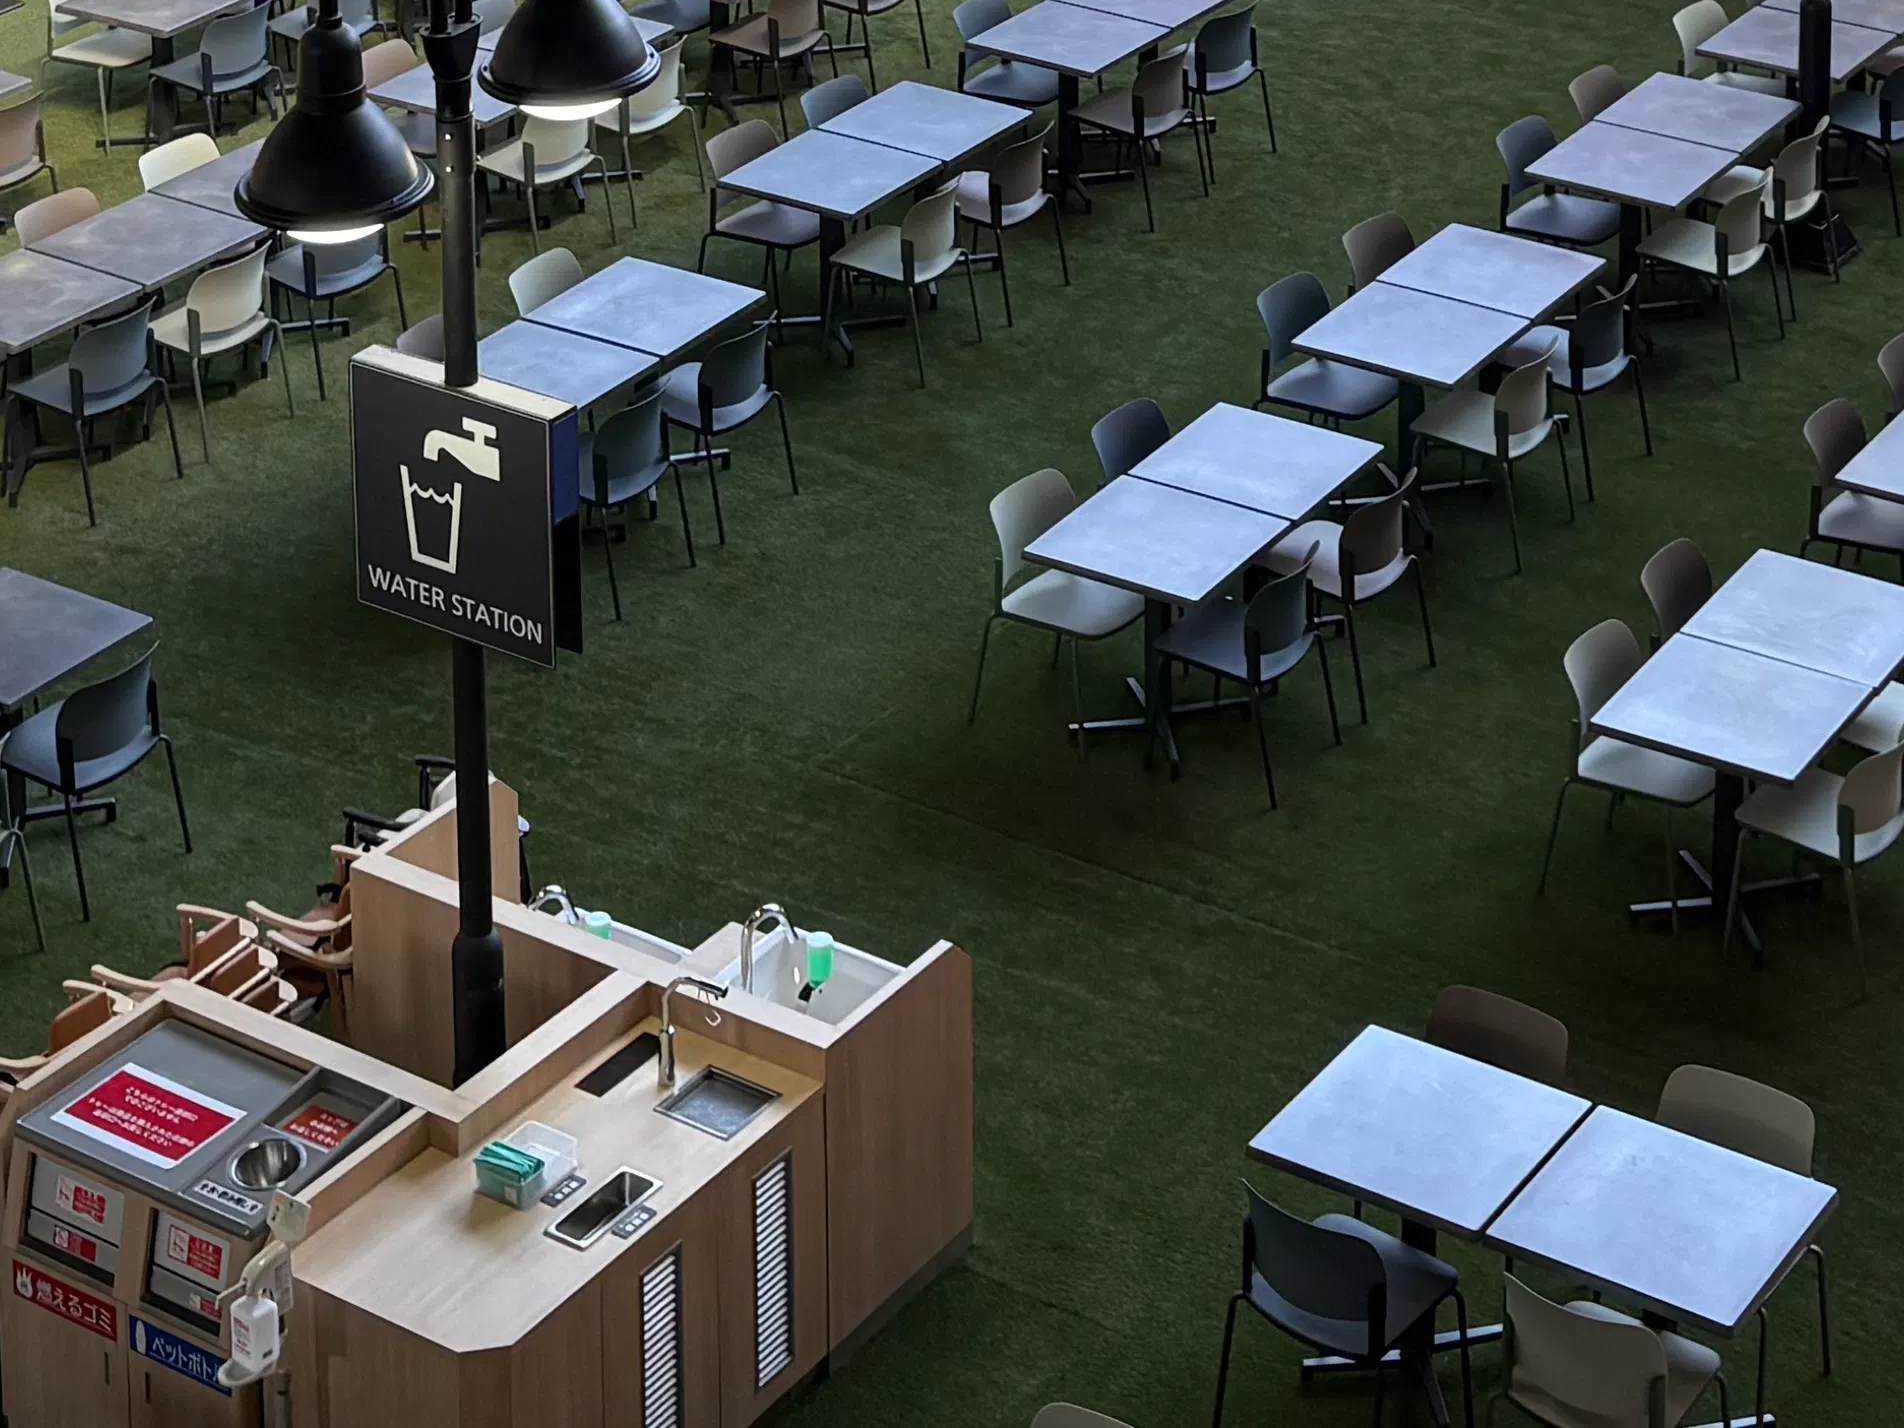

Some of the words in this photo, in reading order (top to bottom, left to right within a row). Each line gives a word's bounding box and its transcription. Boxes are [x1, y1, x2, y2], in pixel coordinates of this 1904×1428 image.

[368, 564, 445, 612] WATER
[451, 594, 542, 644] STATION
[36, 1278, 112, 1332] 燃えるゴミ
